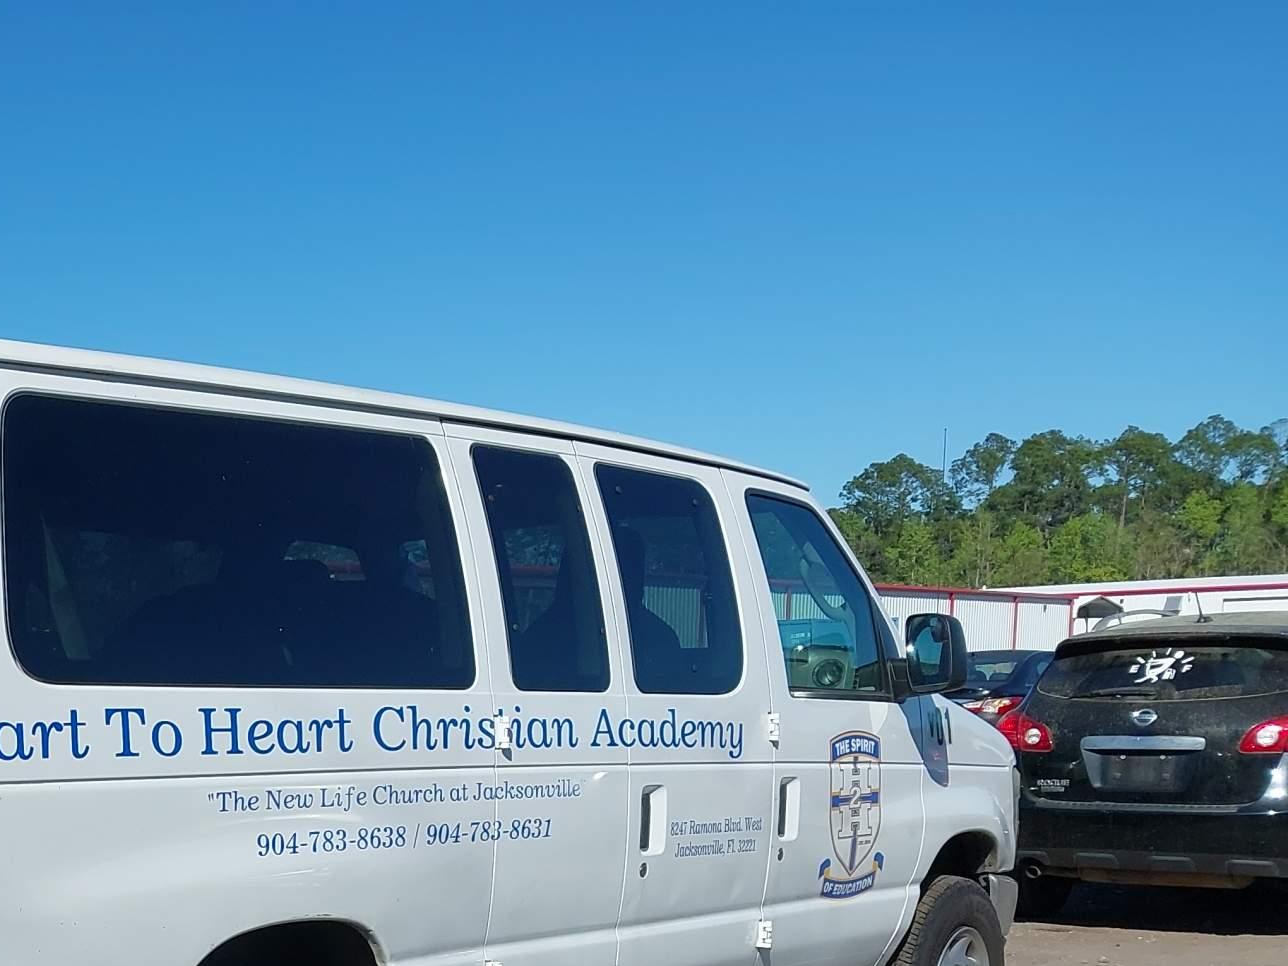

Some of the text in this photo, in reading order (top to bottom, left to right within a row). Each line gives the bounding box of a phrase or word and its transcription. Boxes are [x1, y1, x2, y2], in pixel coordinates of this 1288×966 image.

[104, 707, 183, 758] To
[198, 706, 354, 755] Heart
[373, 704, 579, 752] Chrisian
[590, 708, 743, 759] Academy
[834, 738, 876, 757] THE SPIRIT
[265, 789, 314, 810] New
[319, 786, 368, 812] Life
[372, 783, 445, 805] Church
[449, 783, 469, 802] at
[473, 779, 581, 801] Jacksonville
[257, 818, 553, 857] 904-783-8638 / 904-783-8631
[670, 821, 688, 836] 8247
[688, 820, 723, 835] Ramona
[743, 816, 763, 831] West
[823, 875, 873, 895] OF EDUCATION
